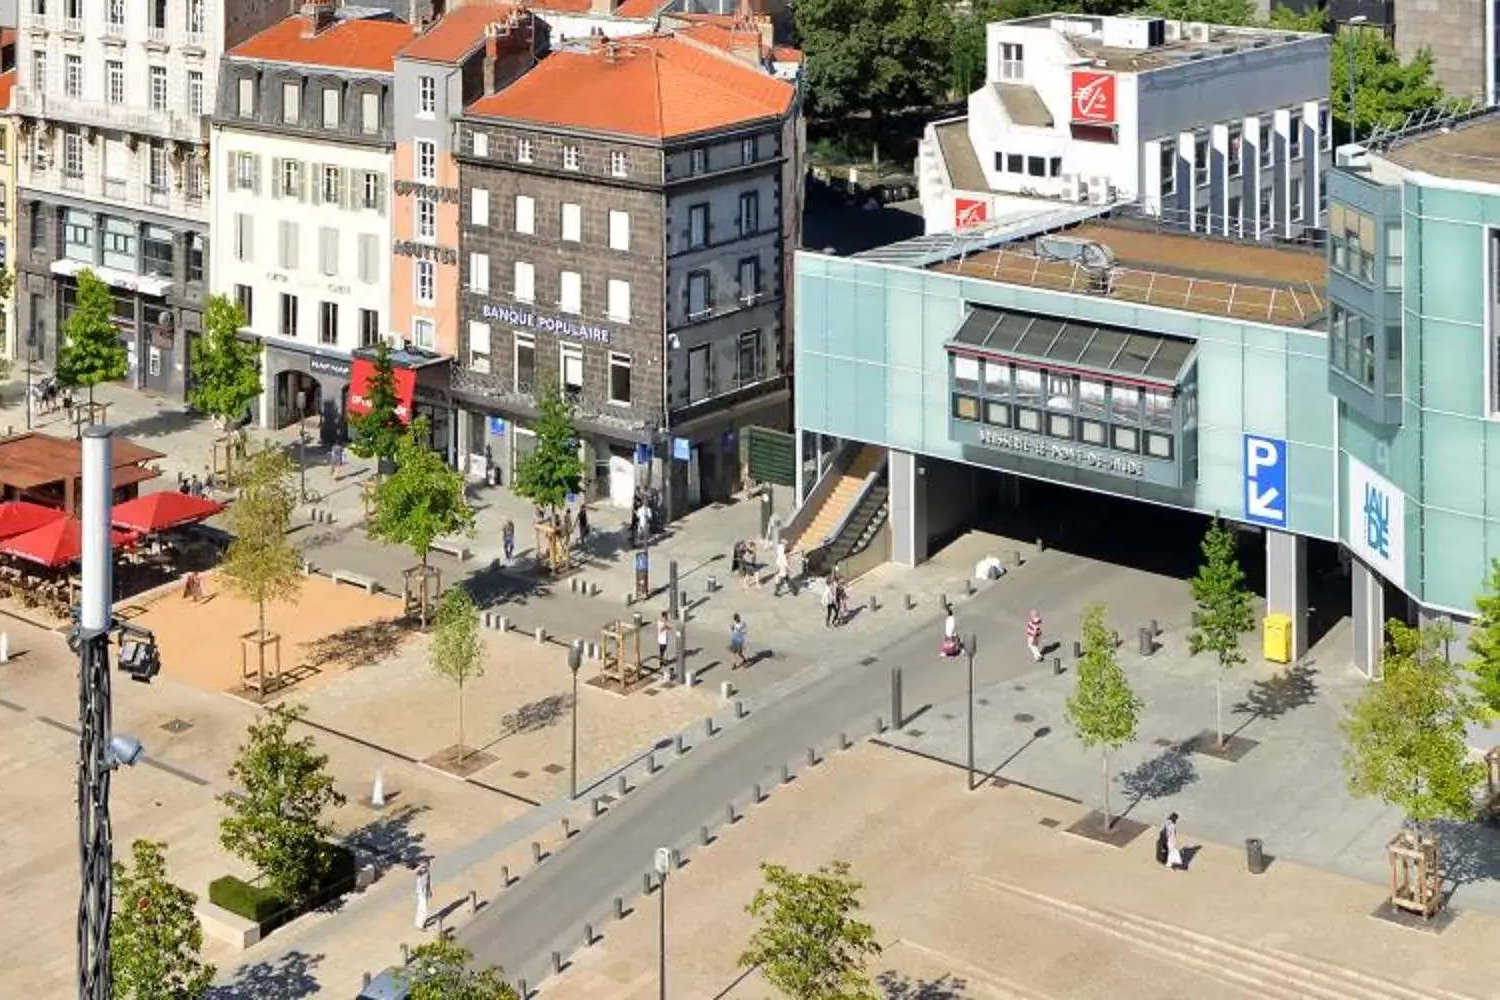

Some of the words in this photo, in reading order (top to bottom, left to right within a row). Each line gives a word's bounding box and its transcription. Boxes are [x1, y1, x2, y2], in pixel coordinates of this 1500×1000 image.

[483, 304, 535, 327] BANQUE
[538, 315, 609, 342] POPULAIRE
[1248, 430, 1278, 477] P
